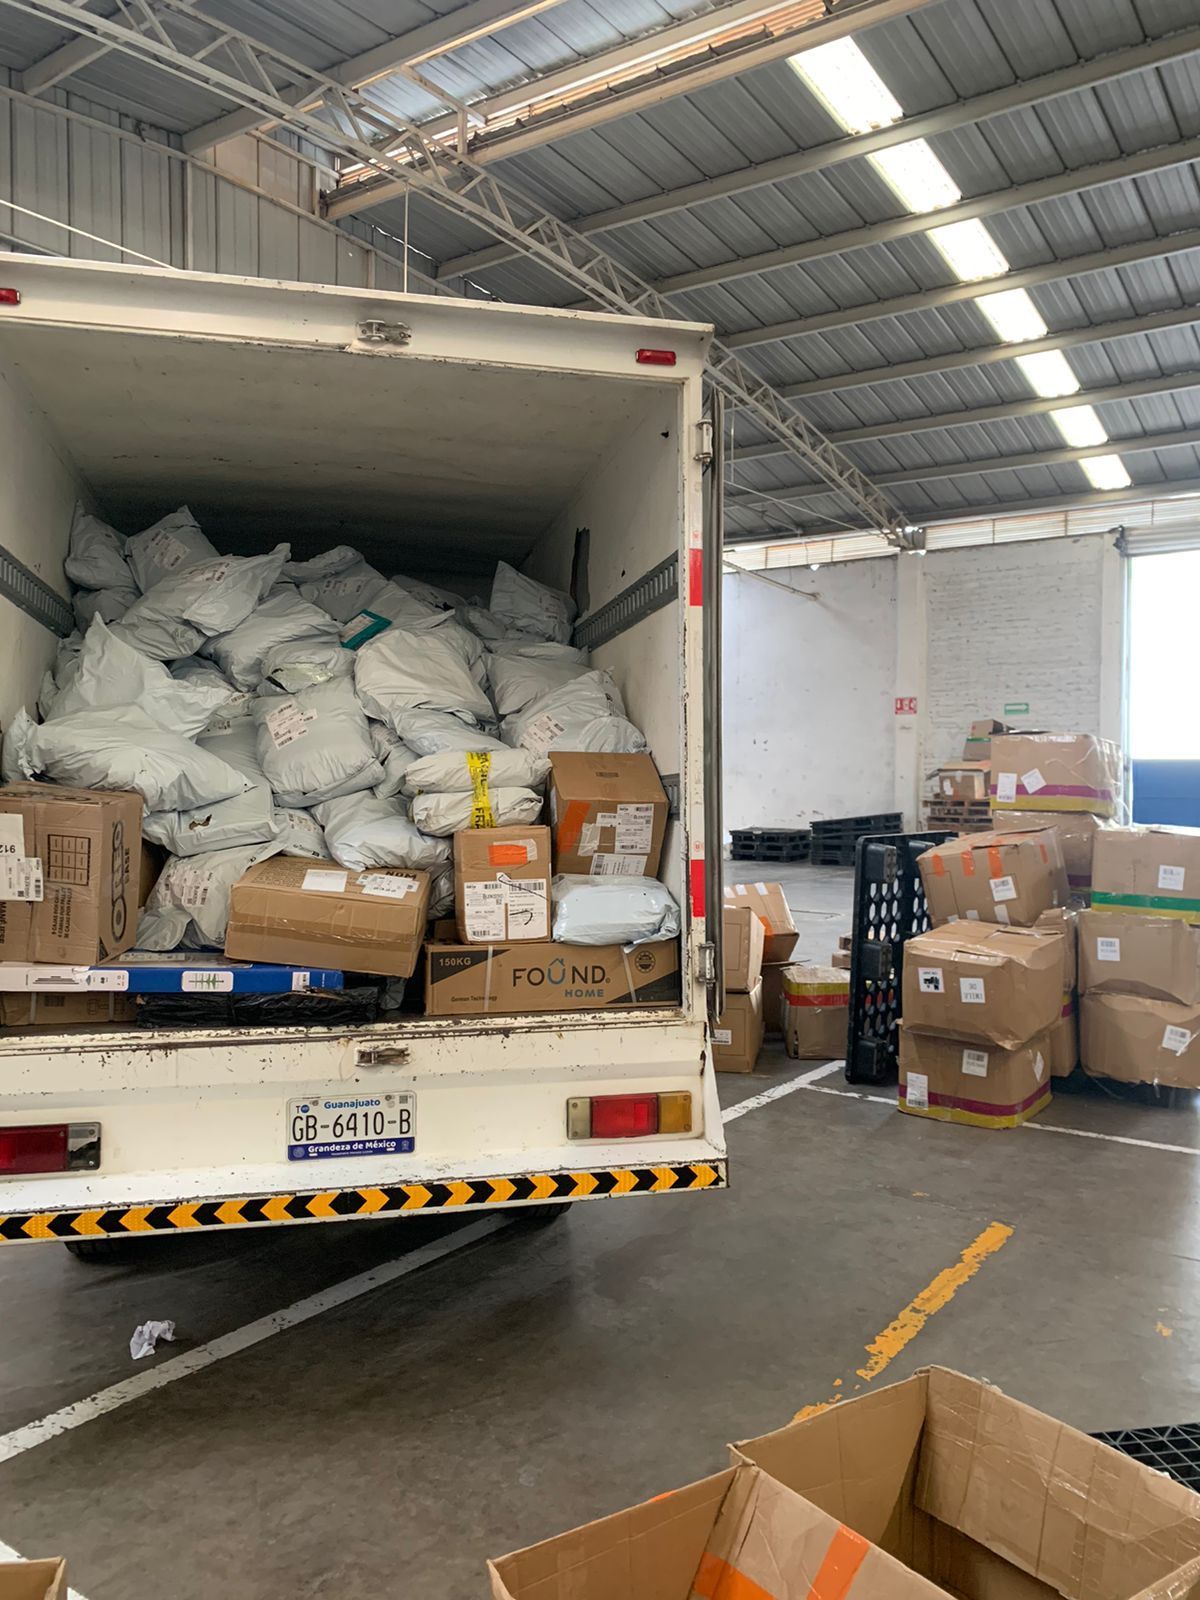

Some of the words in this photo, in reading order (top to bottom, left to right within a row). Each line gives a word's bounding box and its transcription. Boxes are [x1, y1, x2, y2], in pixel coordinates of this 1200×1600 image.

[439, 957, 472, 967] 150KG
[564, 989, 605, 998] HOME
[324, 1099, 381, 1109] Guanajuato
[292, 1109, 412, 1142] GB-6410-B
[307, 1143, 351, 1153] Grandeza
[352, 1141, 364, 1150] de
[365, 1140, 397, 1149] México
